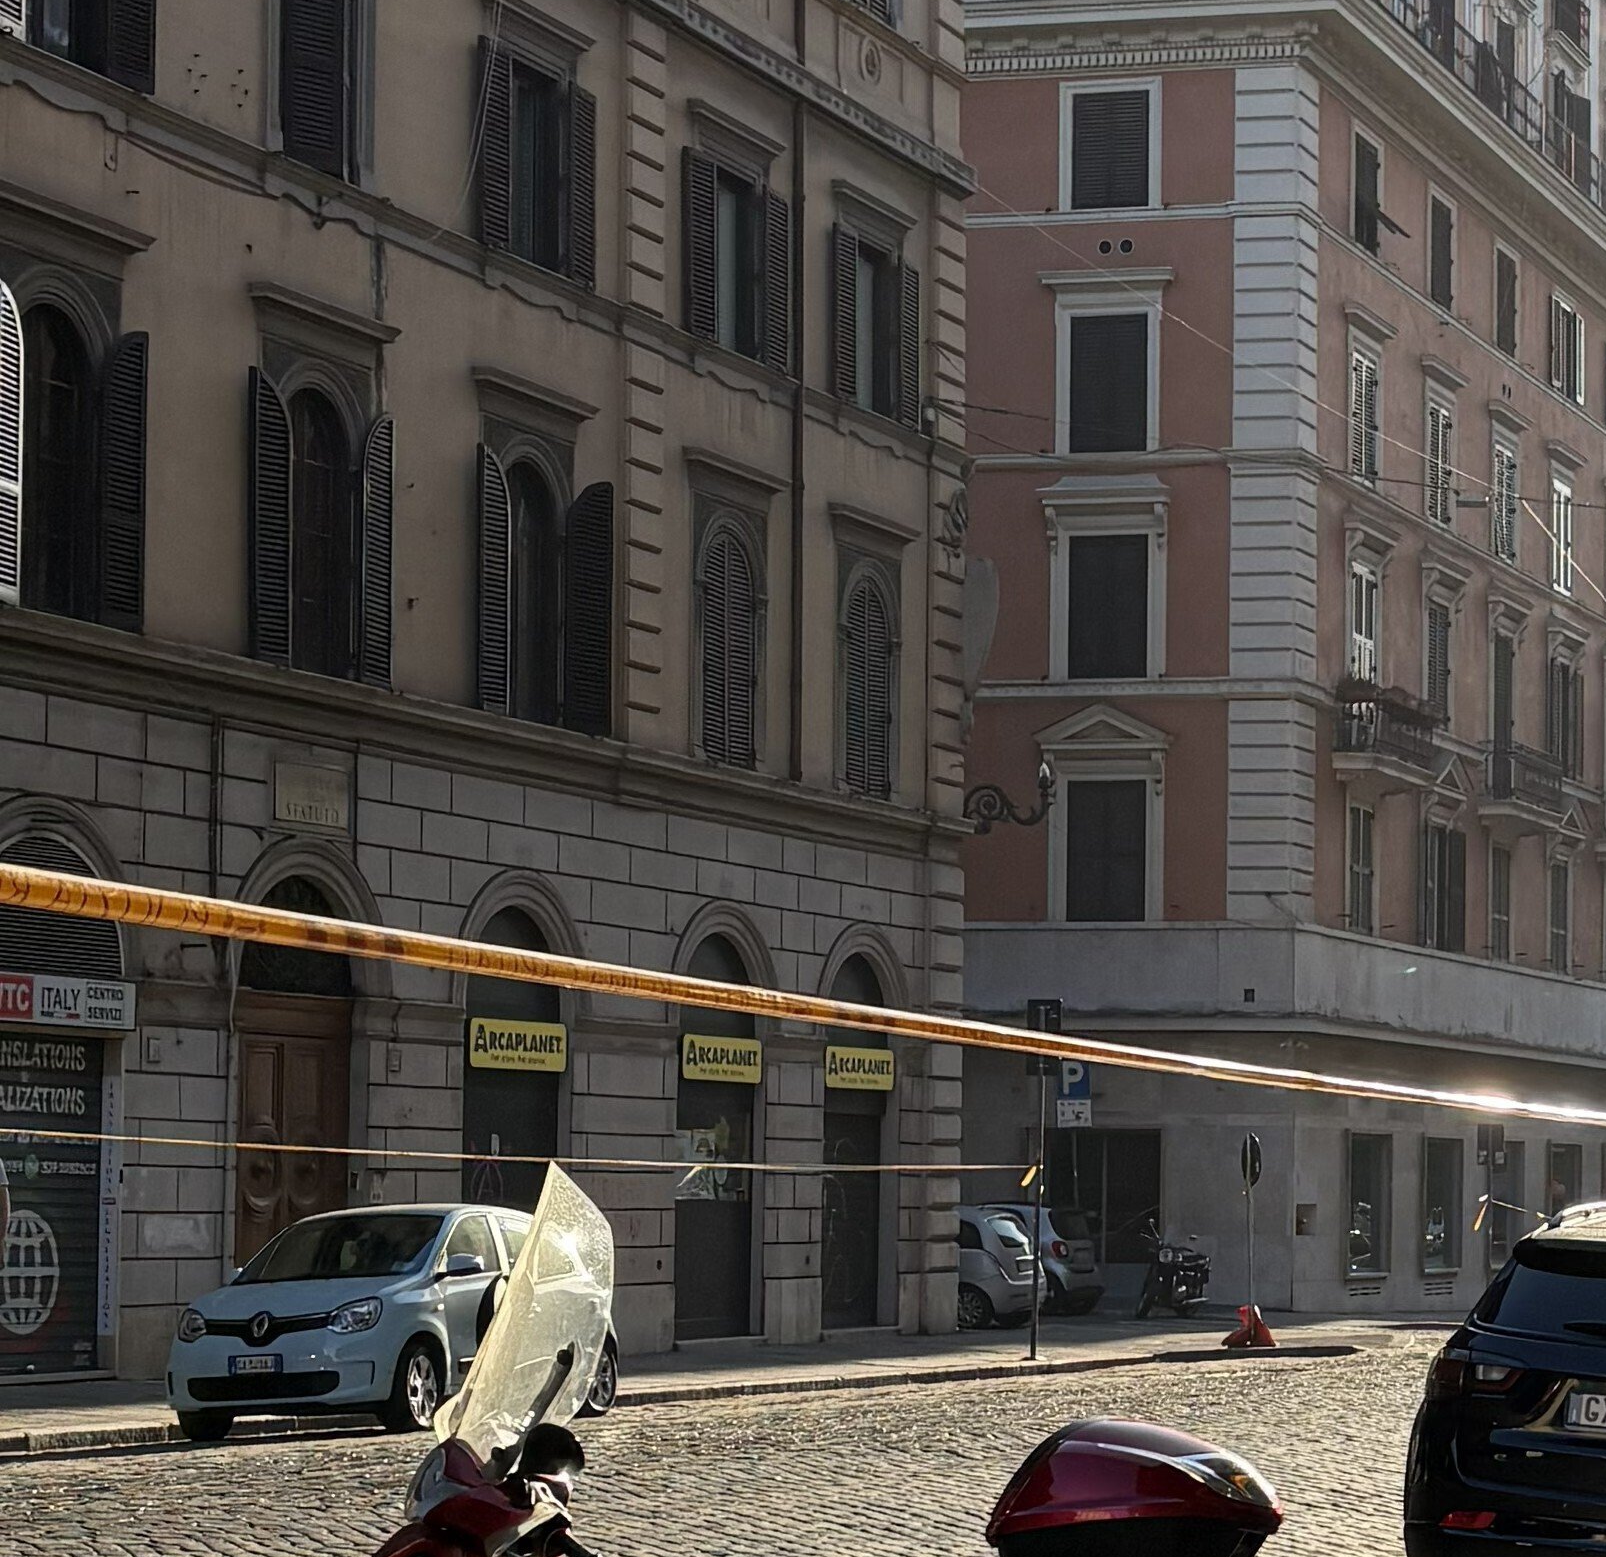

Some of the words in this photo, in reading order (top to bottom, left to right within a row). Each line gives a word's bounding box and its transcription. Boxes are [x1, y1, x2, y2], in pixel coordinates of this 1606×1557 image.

[41, 986, 81, 1012] ITALY
[86, 985, 124, 1001] CENTRO
[1062, 1061, 1084, 1096] P
